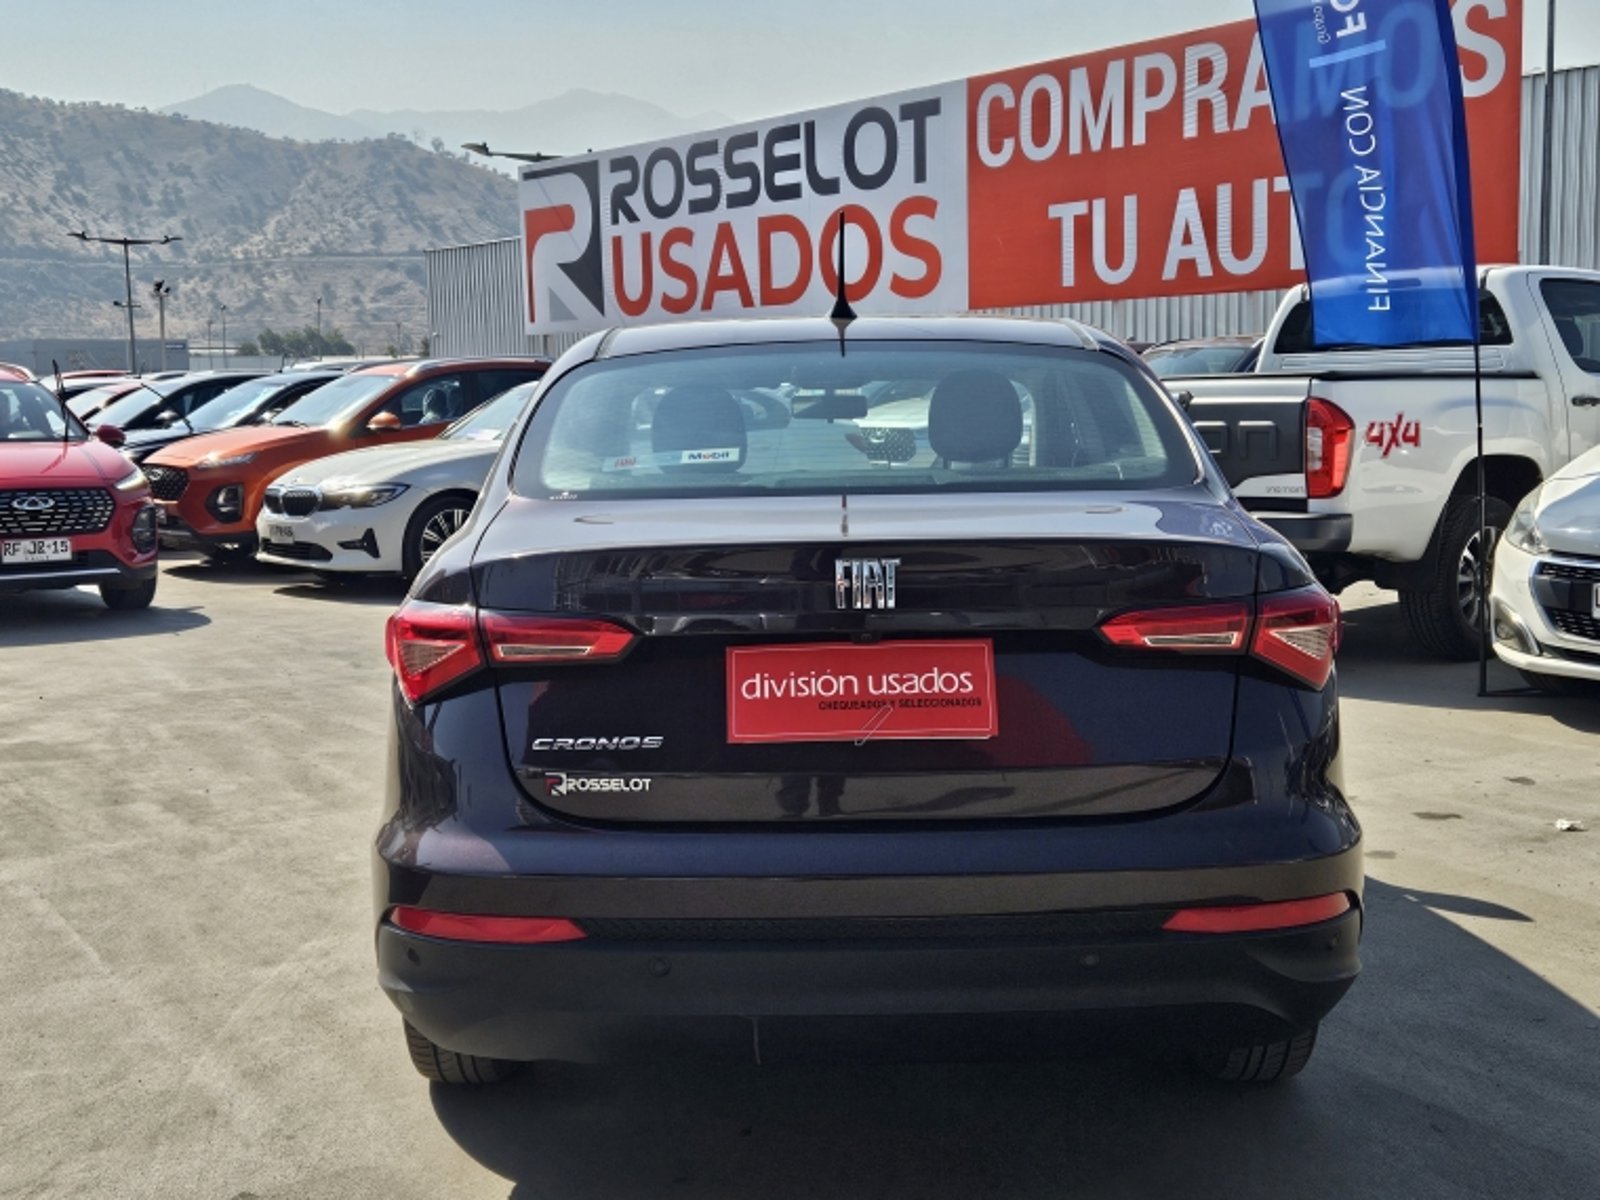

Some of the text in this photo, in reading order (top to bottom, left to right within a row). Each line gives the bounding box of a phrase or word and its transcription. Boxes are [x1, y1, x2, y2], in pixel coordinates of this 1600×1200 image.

[609, 97, 942, 225] ROSSELOT
[611, 195, 942, 317] USADOS
[1048, 194, 1138, 287] TU
[835, 558, 901, 609] FIAT
[741, 667, 973, 699] división usados
[898, 697, 982, 709] SELECCIONADOS
[532, 736, 664, 751] CRONOS
[566, 778, 651, 792] ROSSELOT
